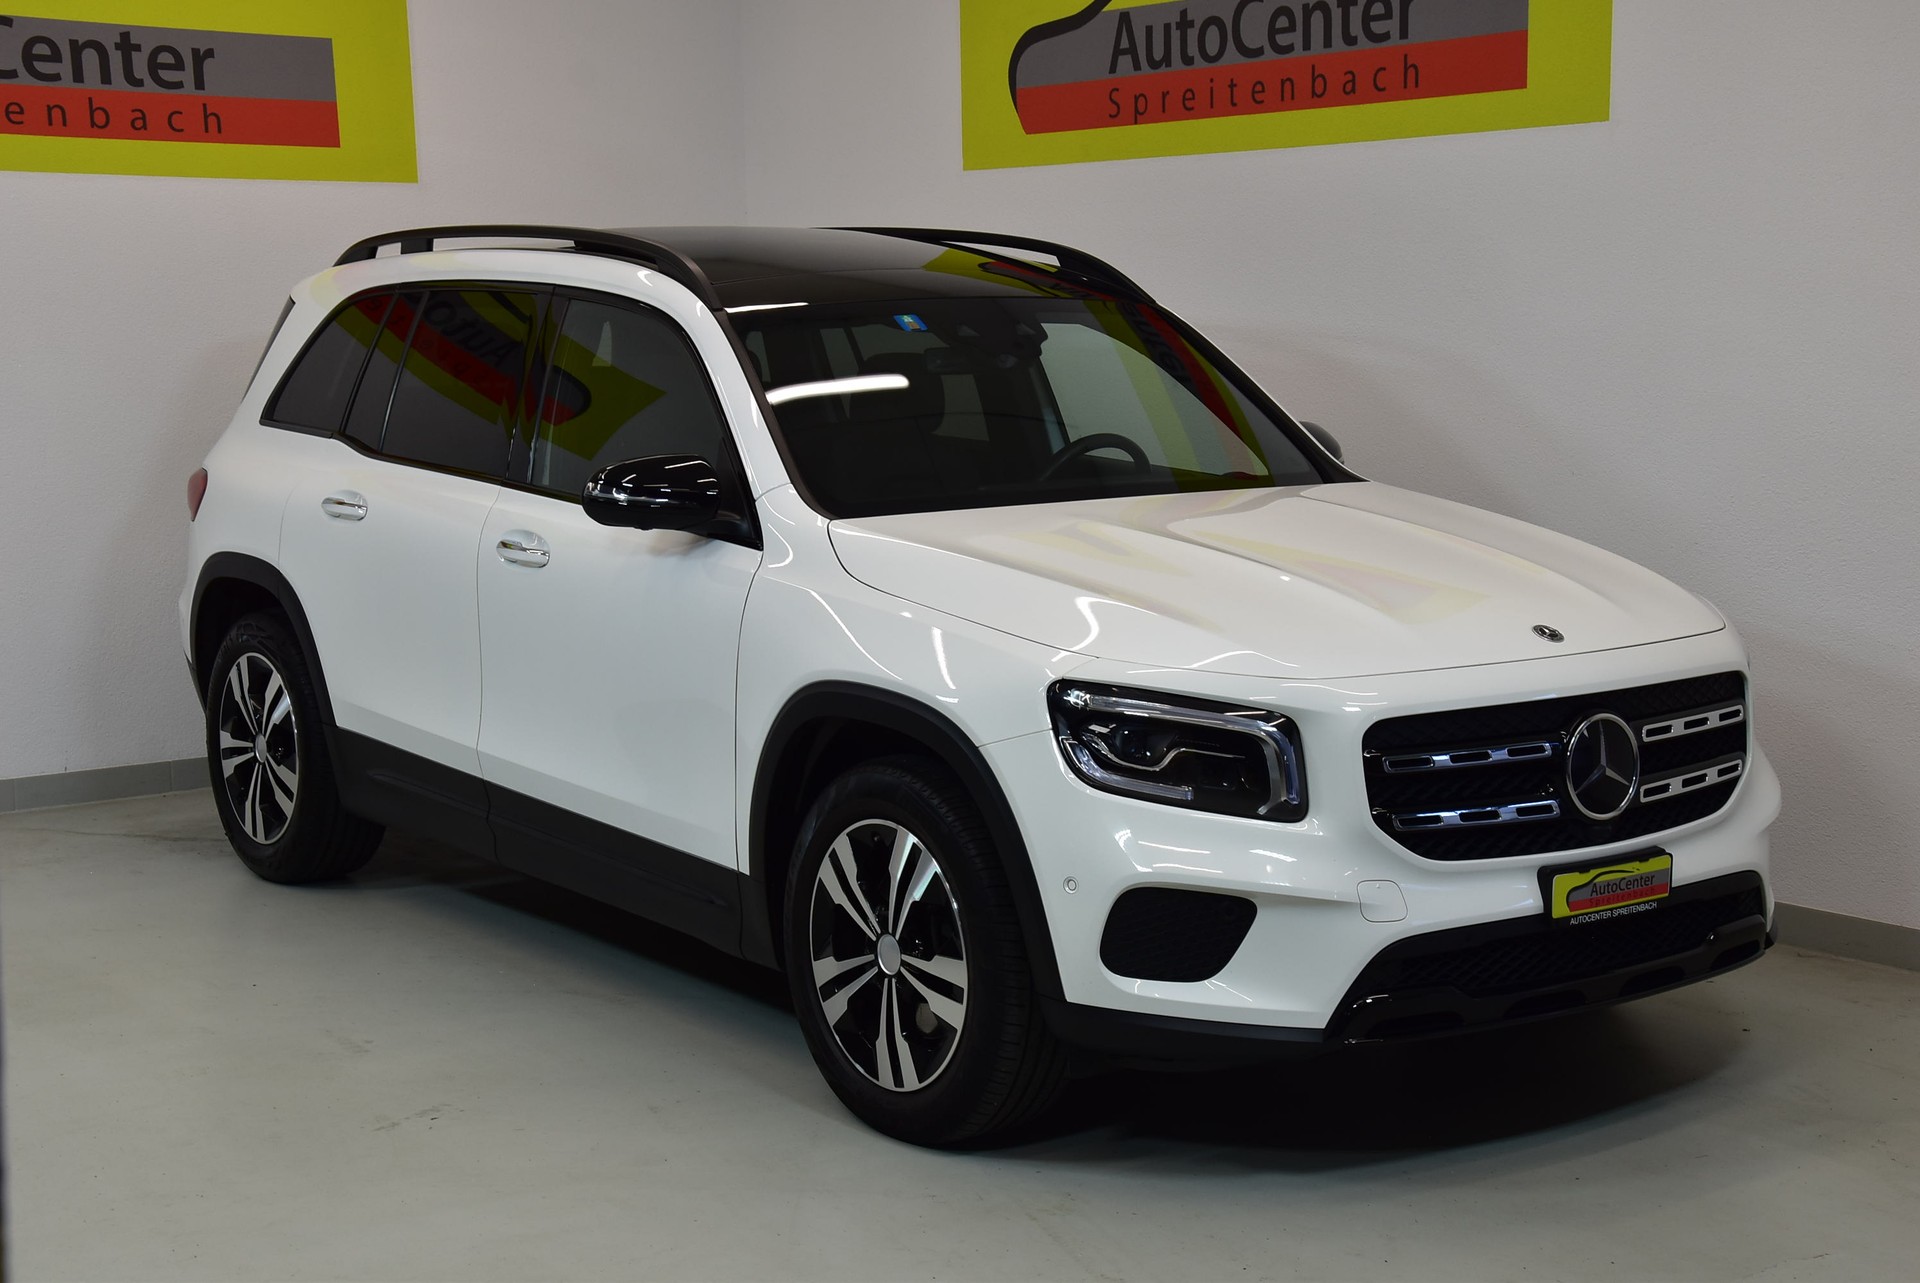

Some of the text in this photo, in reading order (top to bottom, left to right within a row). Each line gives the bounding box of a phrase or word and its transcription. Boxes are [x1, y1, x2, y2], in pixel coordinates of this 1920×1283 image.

[1108, 0, 1415, 74] AutoCenter
[1108, 53, 1420, 125] Spreitenbach
[4, 97, 222, 134] enbach
[1590, 875, 1656, 896] AutoCenter
[1570, 902, 1658, 925] AUTOCENTER SPREITENBACH
